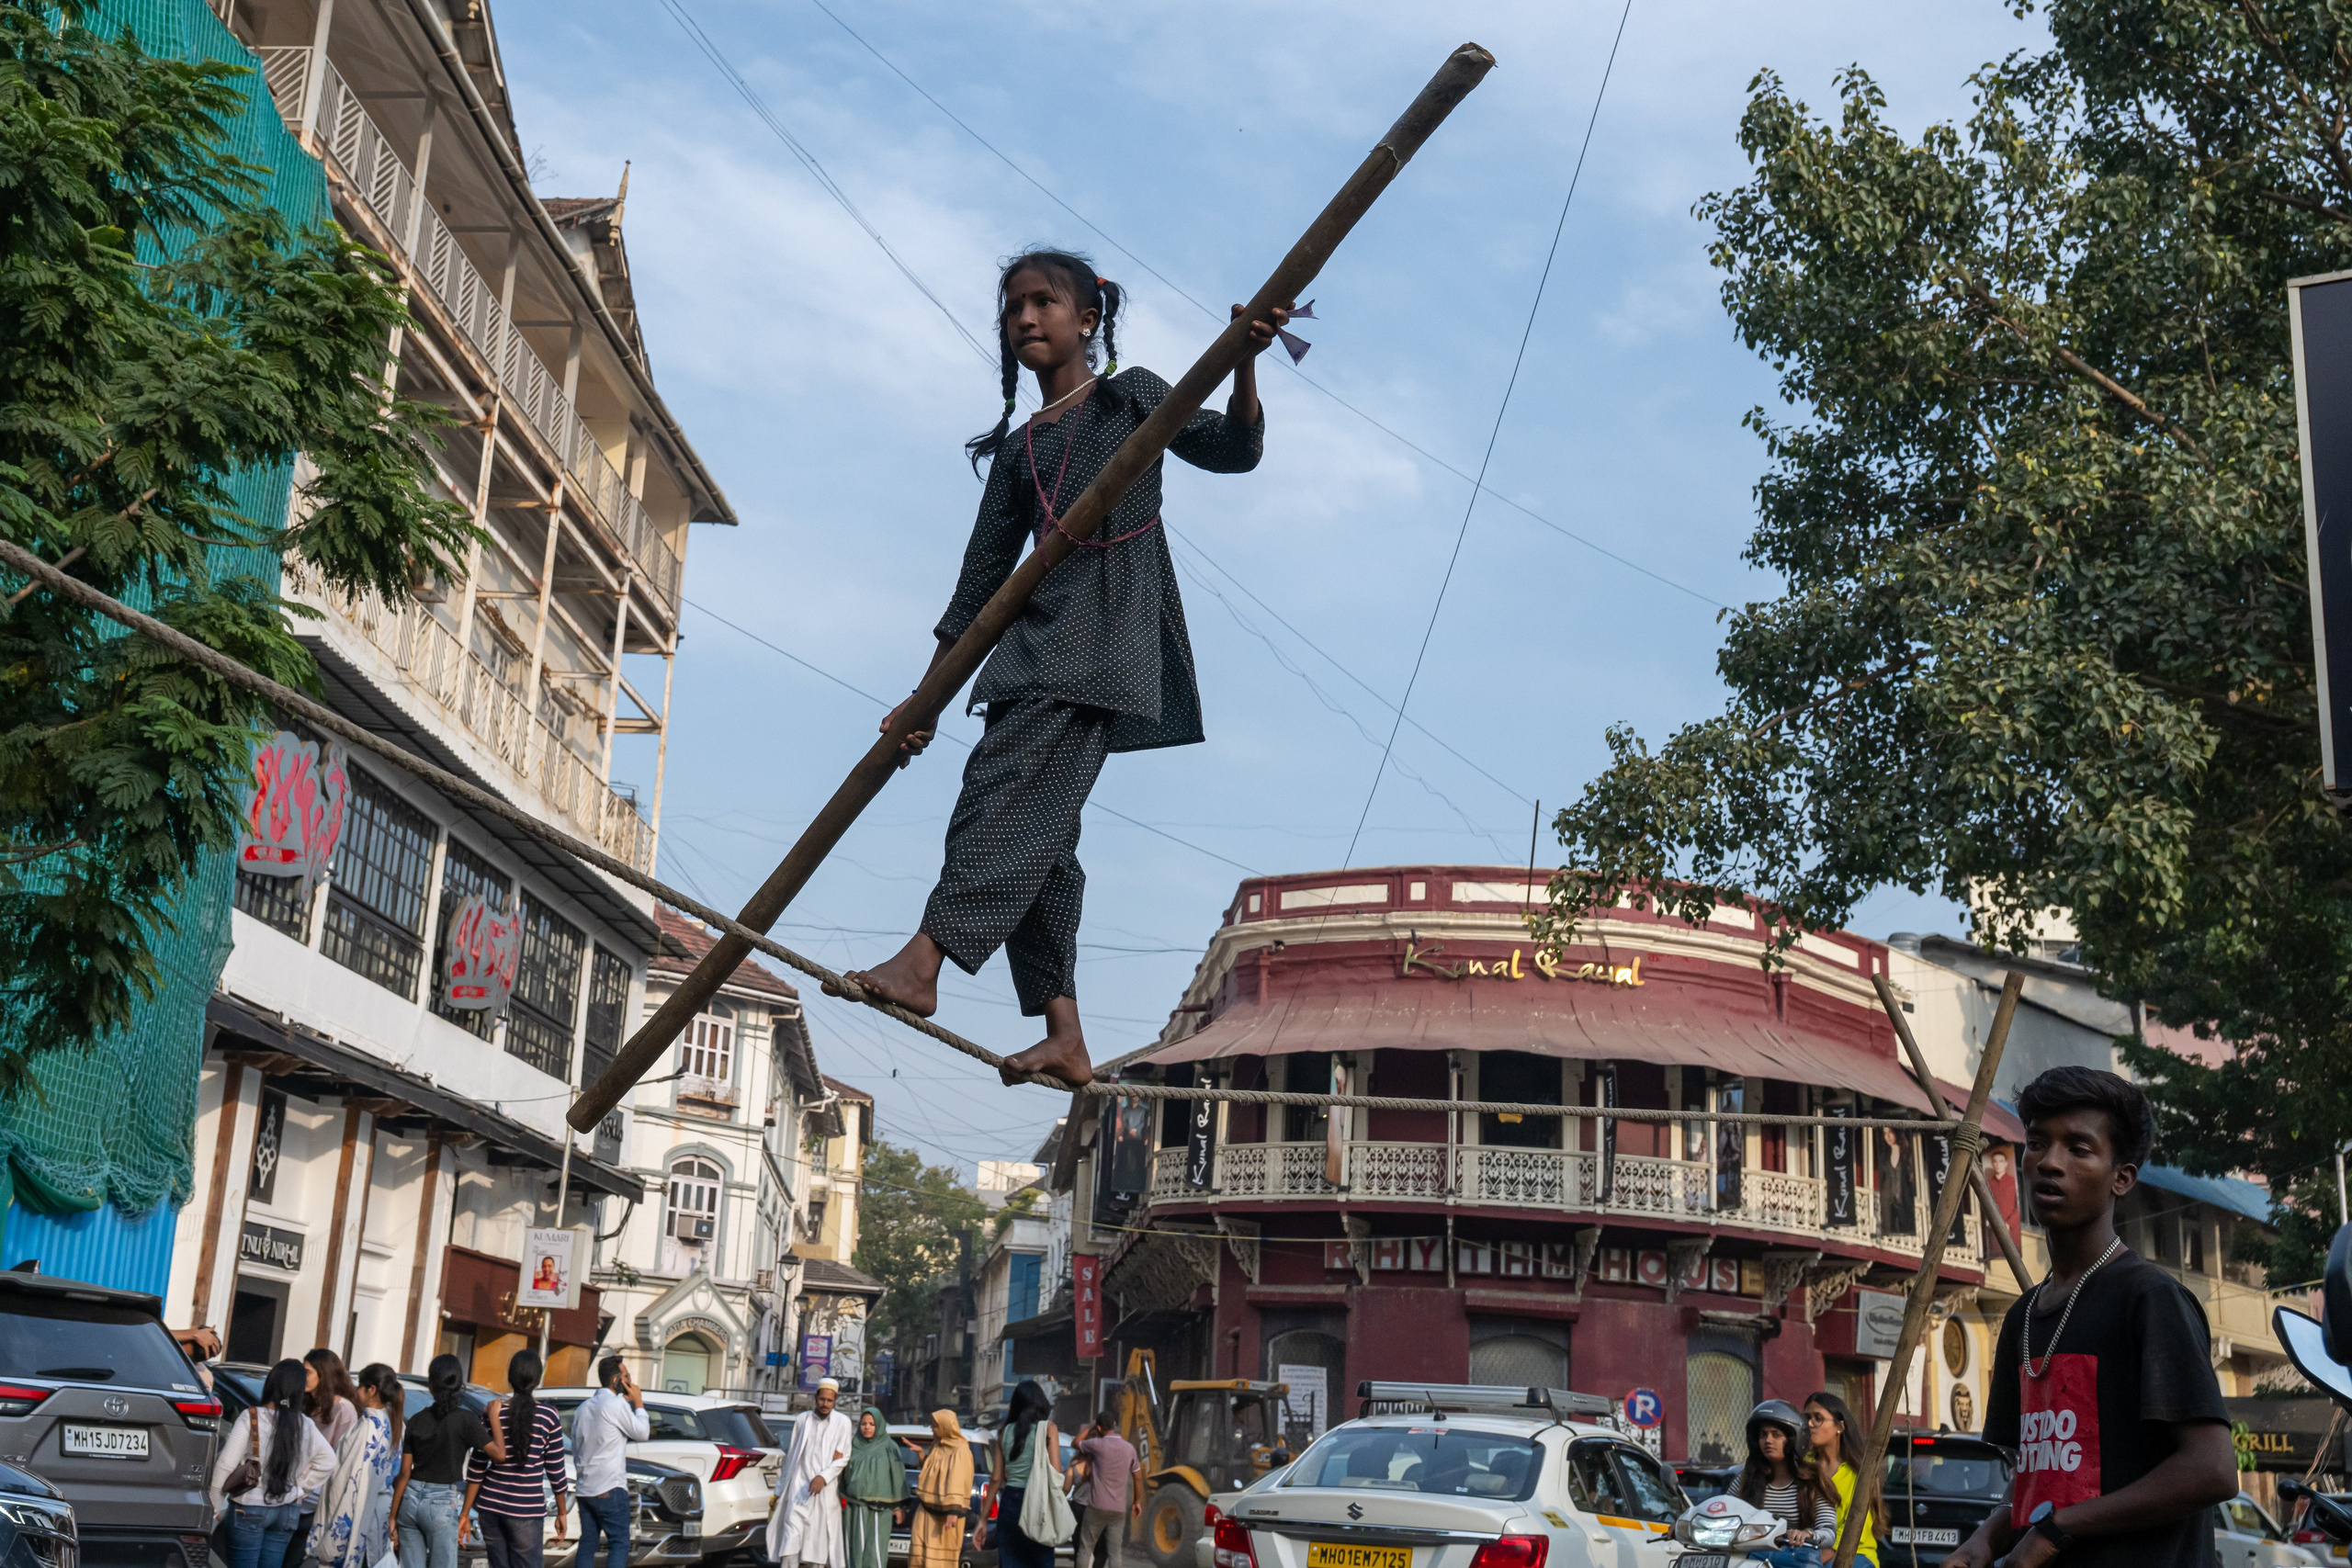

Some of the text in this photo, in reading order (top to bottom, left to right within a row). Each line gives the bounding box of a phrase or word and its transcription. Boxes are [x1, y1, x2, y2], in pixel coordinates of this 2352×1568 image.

[1403, 943, 1525, 979] Kunal
[1834, 1165, 1849, 1218] Kunal
[1325, 1239, 1571, 1278] RHYTHM
[1081, 1267, 1095, 1344] SALE
[1634, 1394, 1657, 1420] P
[74, 1429, 147, 1451] MH15JD7234
[2233, 1432, 2294, 1453] GRILL
[1258, 1452, 1271, 1462] JC
[1319, 1547, 1407, 1568] MH01EM7125
